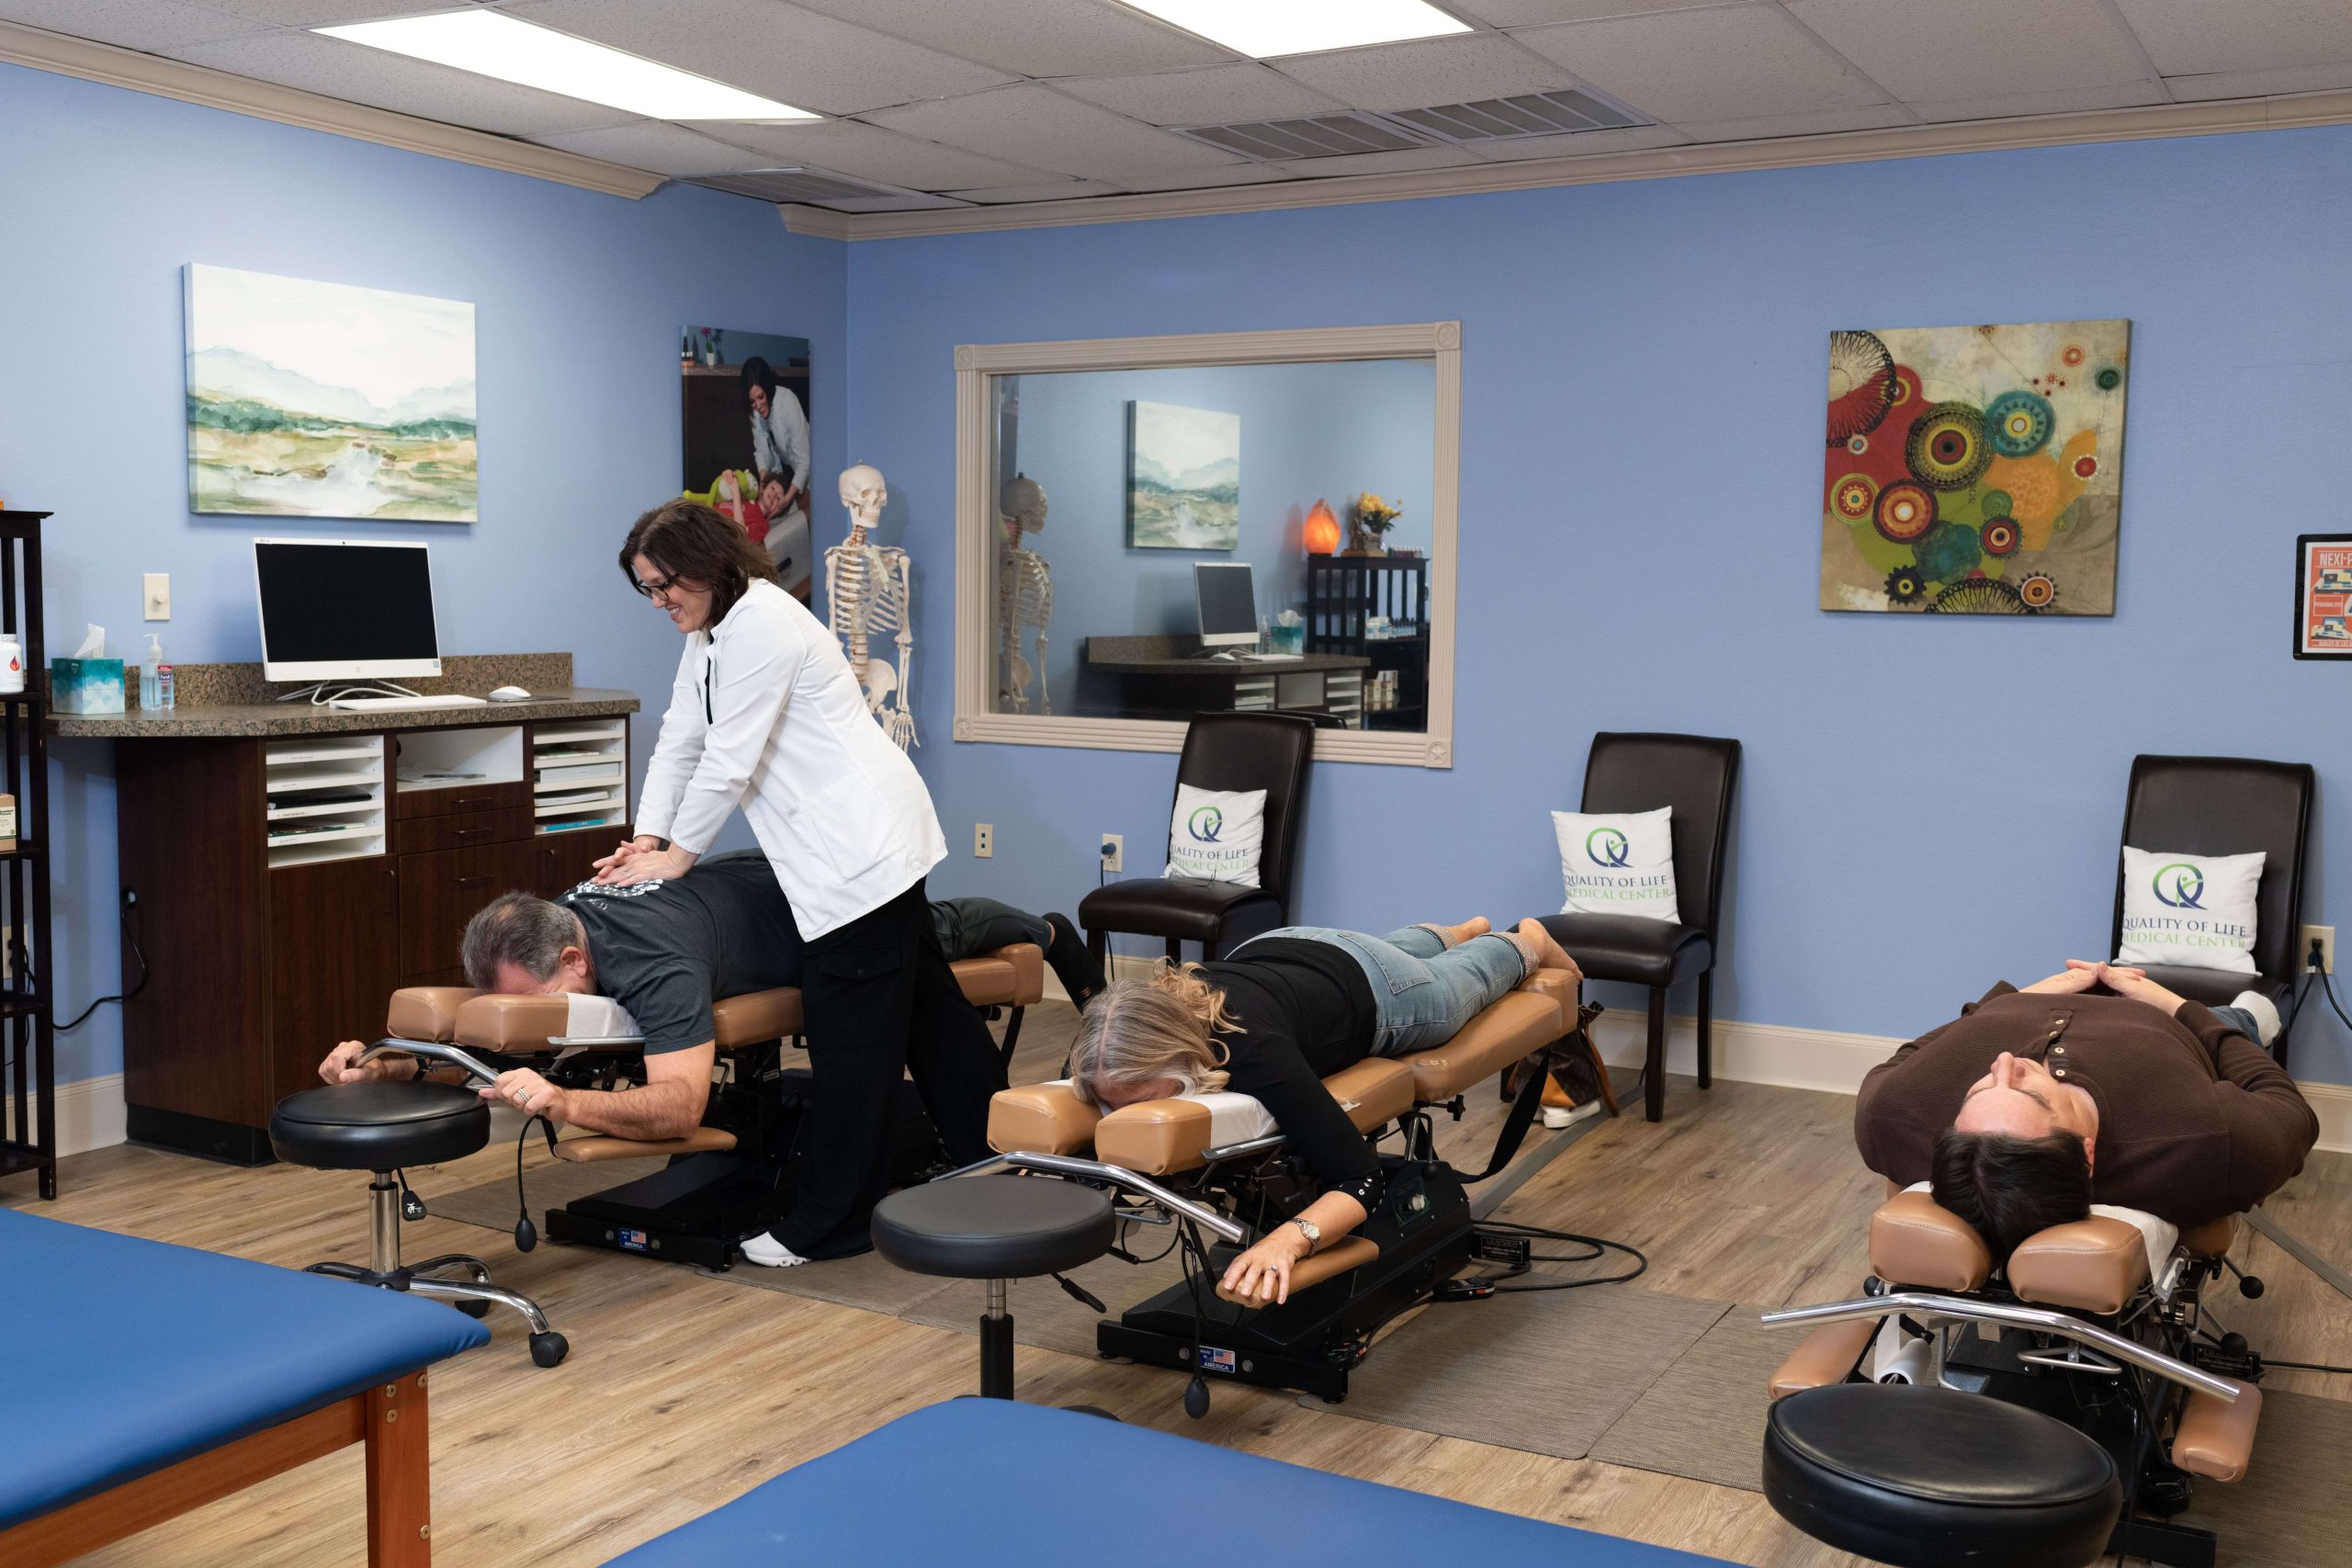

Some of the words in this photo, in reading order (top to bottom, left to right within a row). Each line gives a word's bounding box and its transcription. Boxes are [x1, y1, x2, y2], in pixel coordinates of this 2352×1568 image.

[1171, 844, 1204, 859] UALITY
[1207, 851, 1221, 860] OF
[1226, 849, 1249, 860] LIFE
[1206, 860, 1250, 872] CENTER
[1564, 874, 1614, 887] QUALITY
[1618, 877, 1636, 887] OF
[1641, 874, 1668, 886] LIFE
[1619, 887, 1670, 900] CENTER
[2122, 918, 2183, 931] QUALITY
[2187, 919, 2209, 932] OF
[2214, 922, 2246, 937] LIFE
[2186, 934, 2245, 949] CENTER
[1204, 1361, 1229, 1371] AMERICA
